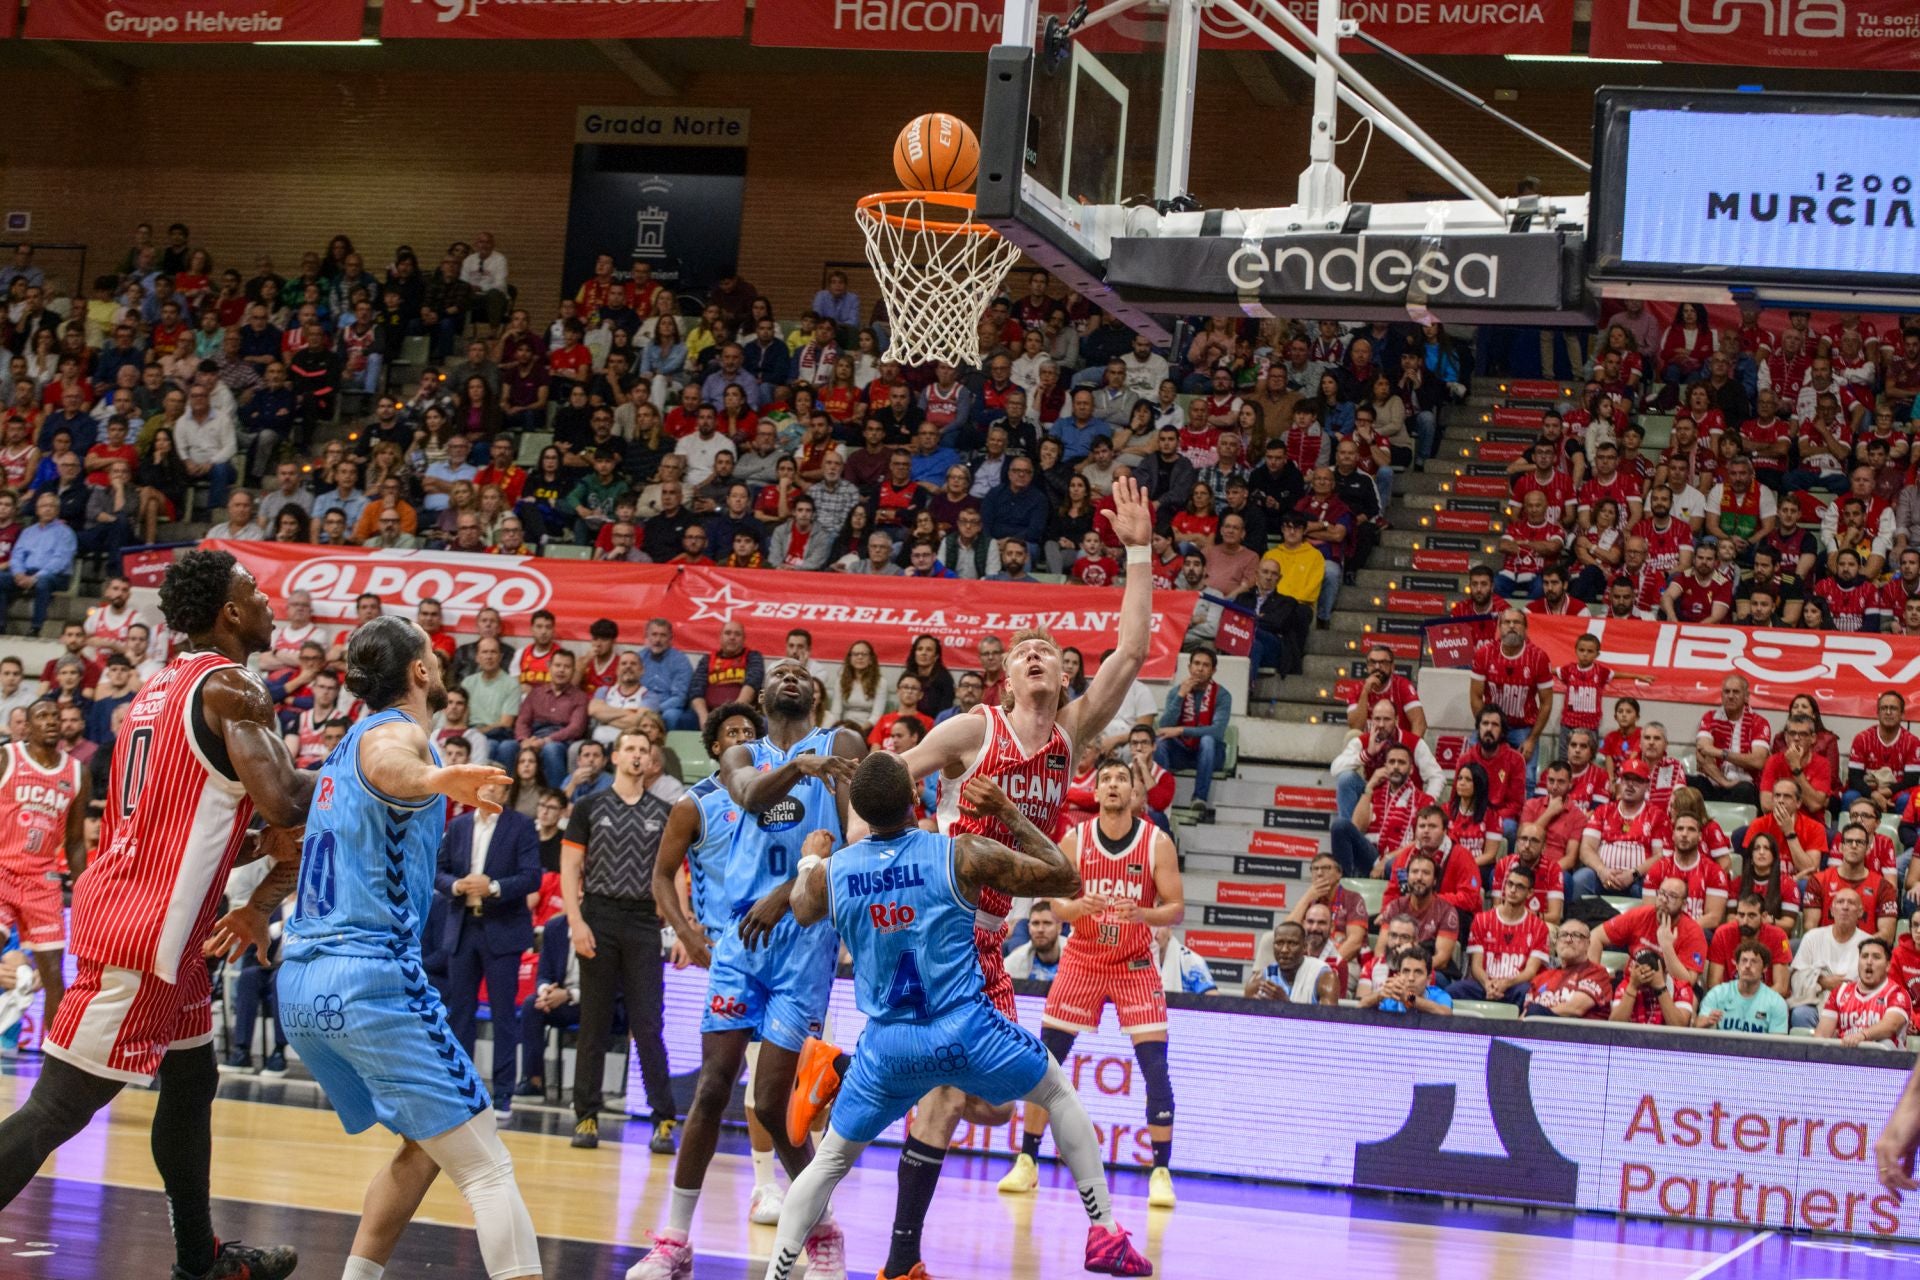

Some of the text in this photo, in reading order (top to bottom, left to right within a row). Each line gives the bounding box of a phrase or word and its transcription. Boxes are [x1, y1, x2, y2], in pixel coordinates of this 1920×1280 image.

[105, 11, 283, 38] Grupo Helvetia
[1397, 2, 1433, 24] DE
[1438, 4, 1545, 25] MURCIA
[1857, 13, 1920, 26] Tu soci
[1857, 26, 1920, 38] tecnoló
[584, 114, 741, 135] Grada Norte
[1816, 172, 1912, 194] 1200
[1706, 191, 1915, 228] MURCIA
[1226, 235, 1498, 298] endesa
[751, 600, 946, 626] ESTRELLA
[954, 614, 981, 625] DE
[1435, 636, 1469, 648] MÓDULO
[1449, 650, 1459, 659] 10
[122, 726, 154, 820] 0
[15, 785, 71, 812] UCAM
[768, 844, 787, 877] 0
[295, 829, 338, 923] 10
[847, 863, 925, 898] RUSSELL
[1085, 879, 1143, 899] UCAM
[869, 901, 915, 929] Río
[1099, 925, 1120, 945] 99
[884, 949, 931, 1020] 4
[1840, 1010, 1881, 1029] UCAM
[1623, 1094, 1868, 1161] Asterra
[1619, 1162, 1902, 1235] Partners
